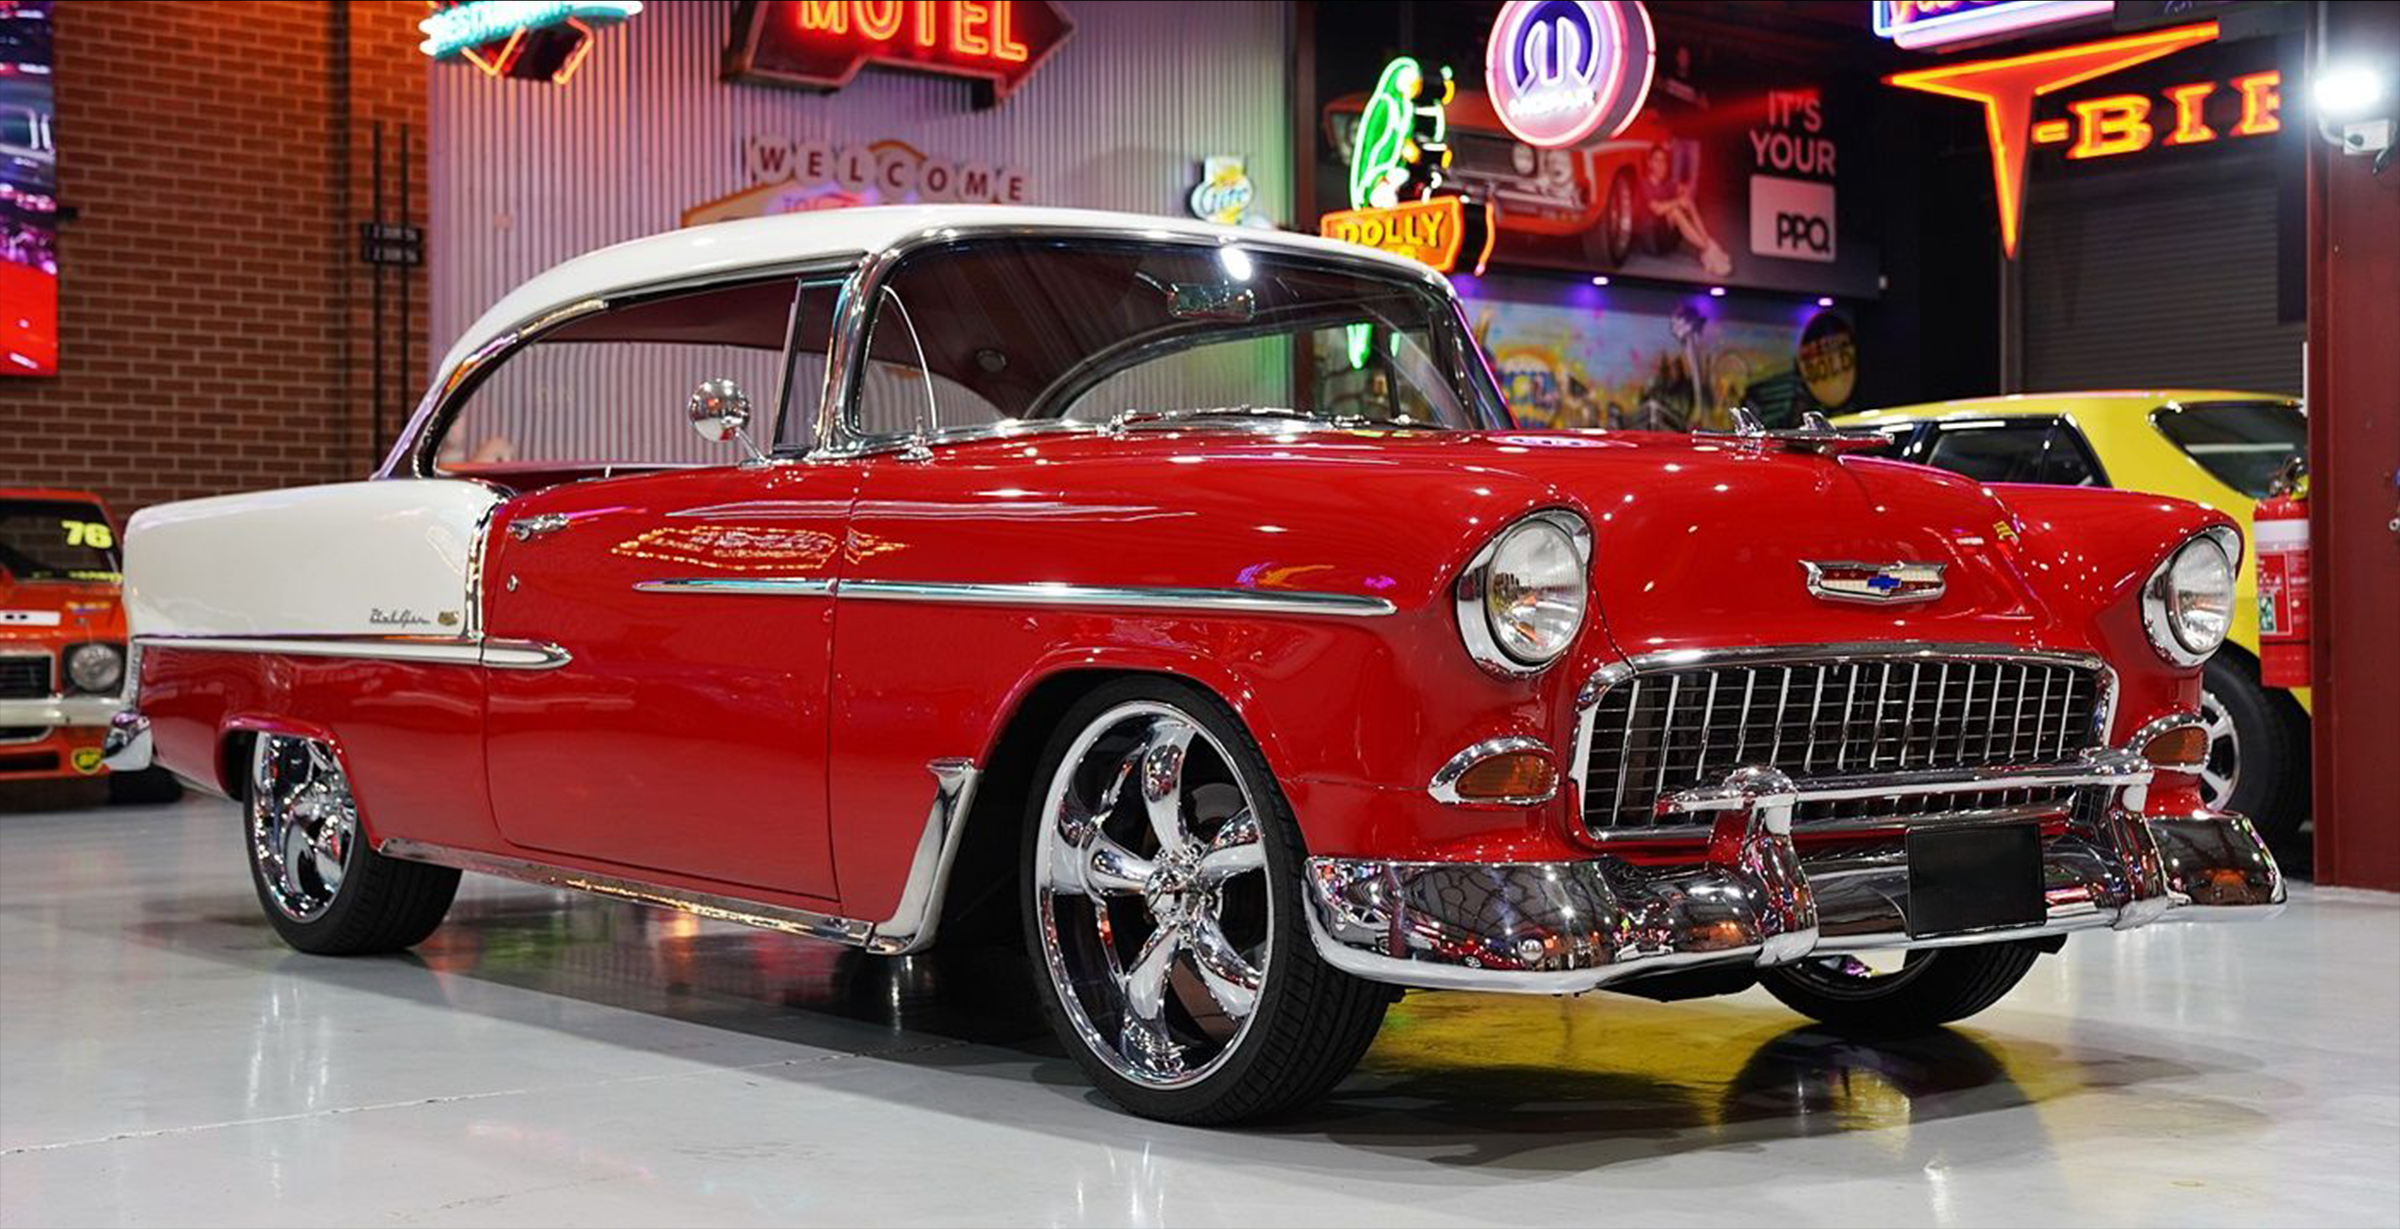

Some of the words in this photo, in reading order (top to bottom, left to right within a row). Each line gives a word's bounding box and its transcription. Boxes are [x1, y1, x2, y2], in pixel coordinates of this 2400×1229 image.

[1768, 91, 1822, 132] IT'S
[1750, 128, 1836, 175] YOUR
[759, 147, 1023, 201] WELCOME
[1337, 210, 1443, 247] DOLLY
[1776, 211, 1830, 254] PPQ
[61, 520, 113, 549] 76
